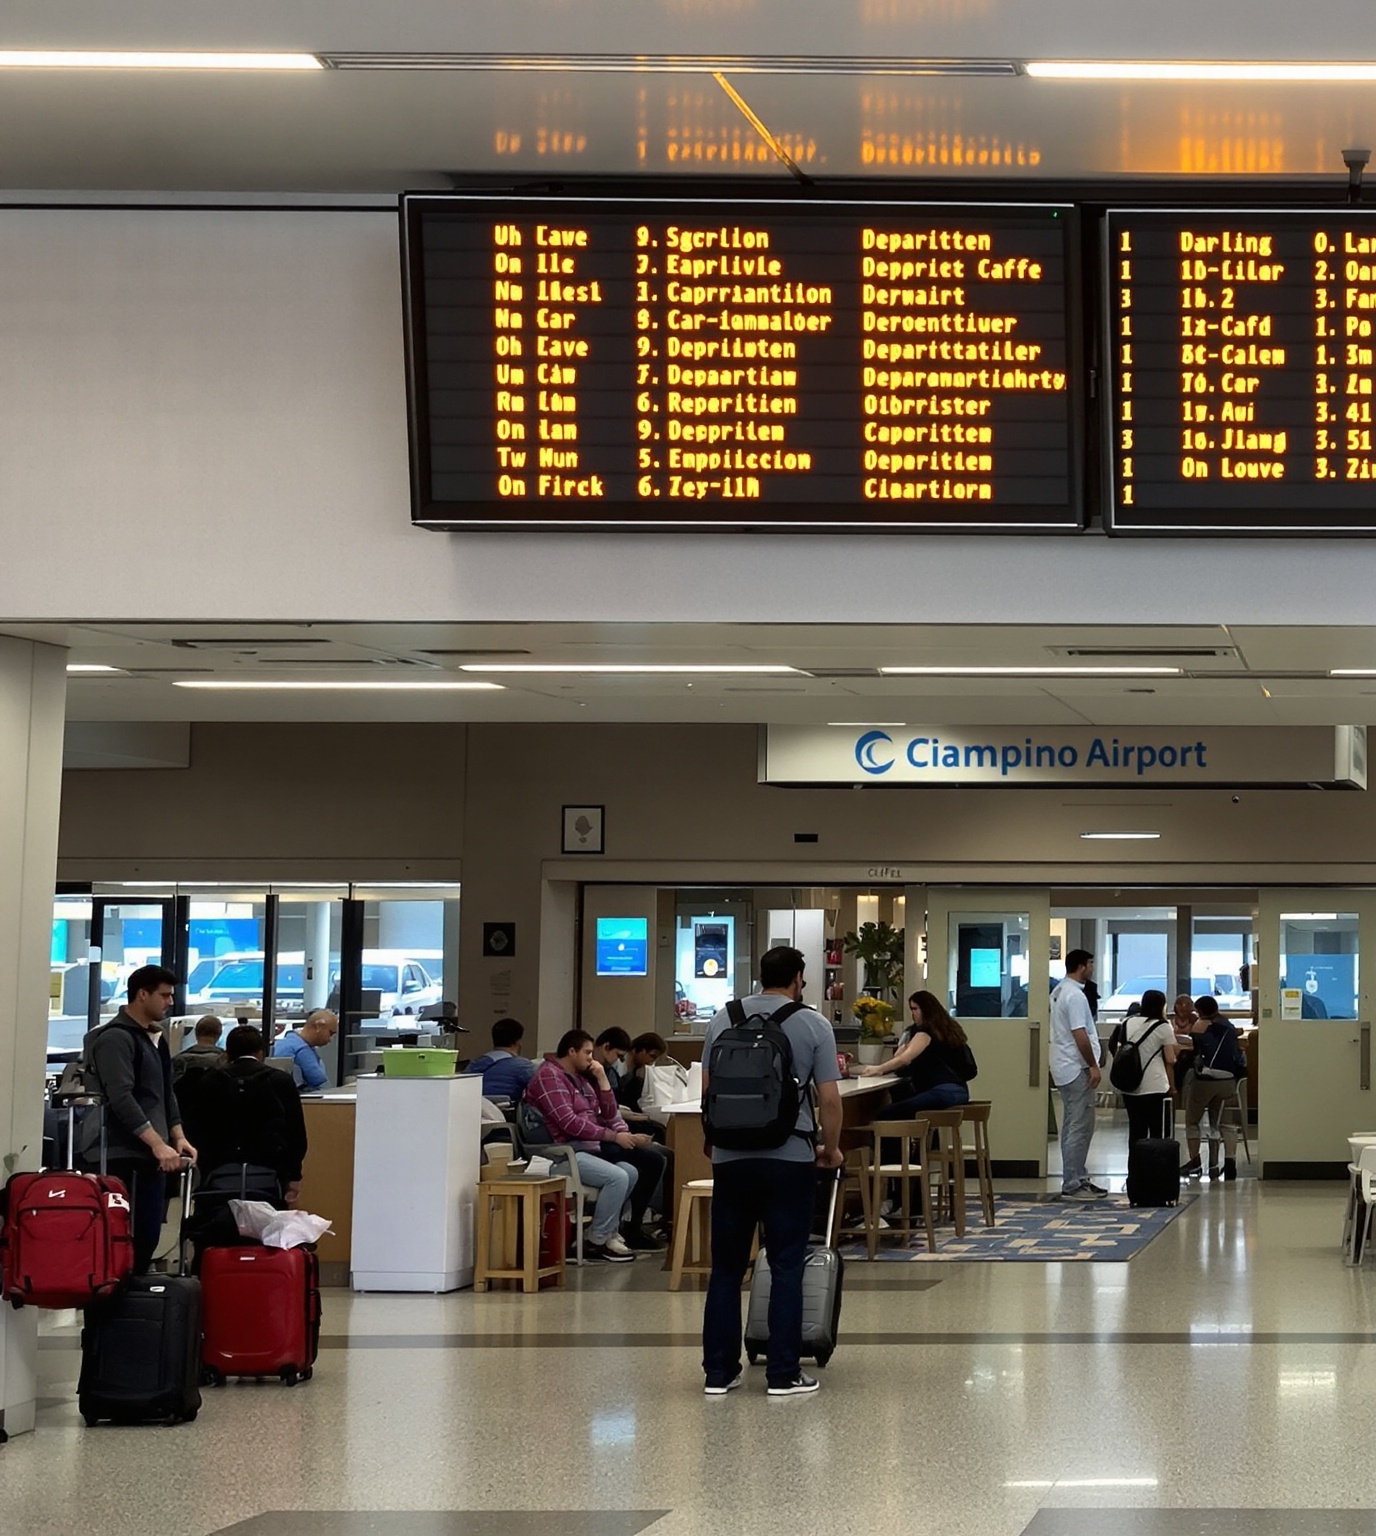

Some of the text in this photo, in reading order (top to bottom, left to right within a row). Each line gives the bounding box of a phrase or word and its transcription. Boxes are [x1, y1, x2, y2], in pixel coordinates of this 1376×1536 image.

[1120, 231, 1132, 252] 1
[1180, 231, 1272, 257] Darling
[977, 258, 1042, 280] Caffe
[1121, 260, 1132, 280] 1
[1314, 260, 1336, 281] 2.
[536, 307, 576, 329] Car
[1121, 316, 1132, 336] 1
[1315, 315, 1336, 337] 1.
[1121, 344, 1133, 364] 1
[1316, 344, 1336, 365] 1.
[636, 391, 659, 413] 6.
[1121, 400, 1133, 421] 1
[1345, 401, 1372, 423] 41
[1315, 429, 1337, 451] 3.
[1347, 429, 1372, 451] 51
[638, 447, 660, 469] 5.
[1122, 457, 1134, 478] 1
[1123, 484, 1134, 504] 1
[906, 736, 1207, 774] Ciampino Airport
